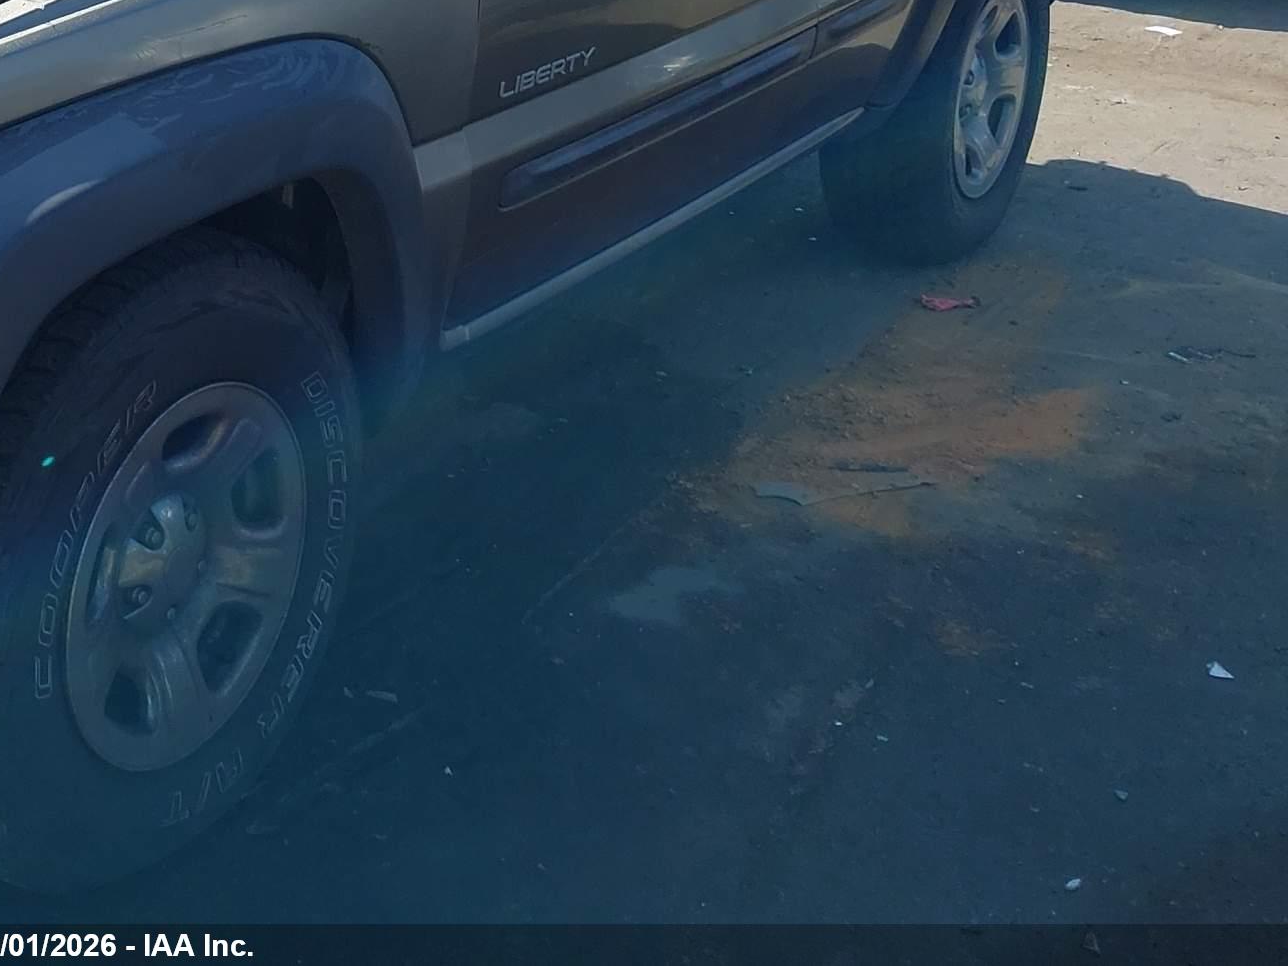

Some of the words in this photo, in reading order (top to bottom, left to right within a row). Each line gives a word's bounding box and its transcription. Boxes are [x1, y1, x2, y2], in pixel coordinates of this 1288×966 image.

[499, 46, 596, 98] LIBERTY
[33, 380, 159, 700] COOPER
[256, 370, 350, 738] DISCOVERER
